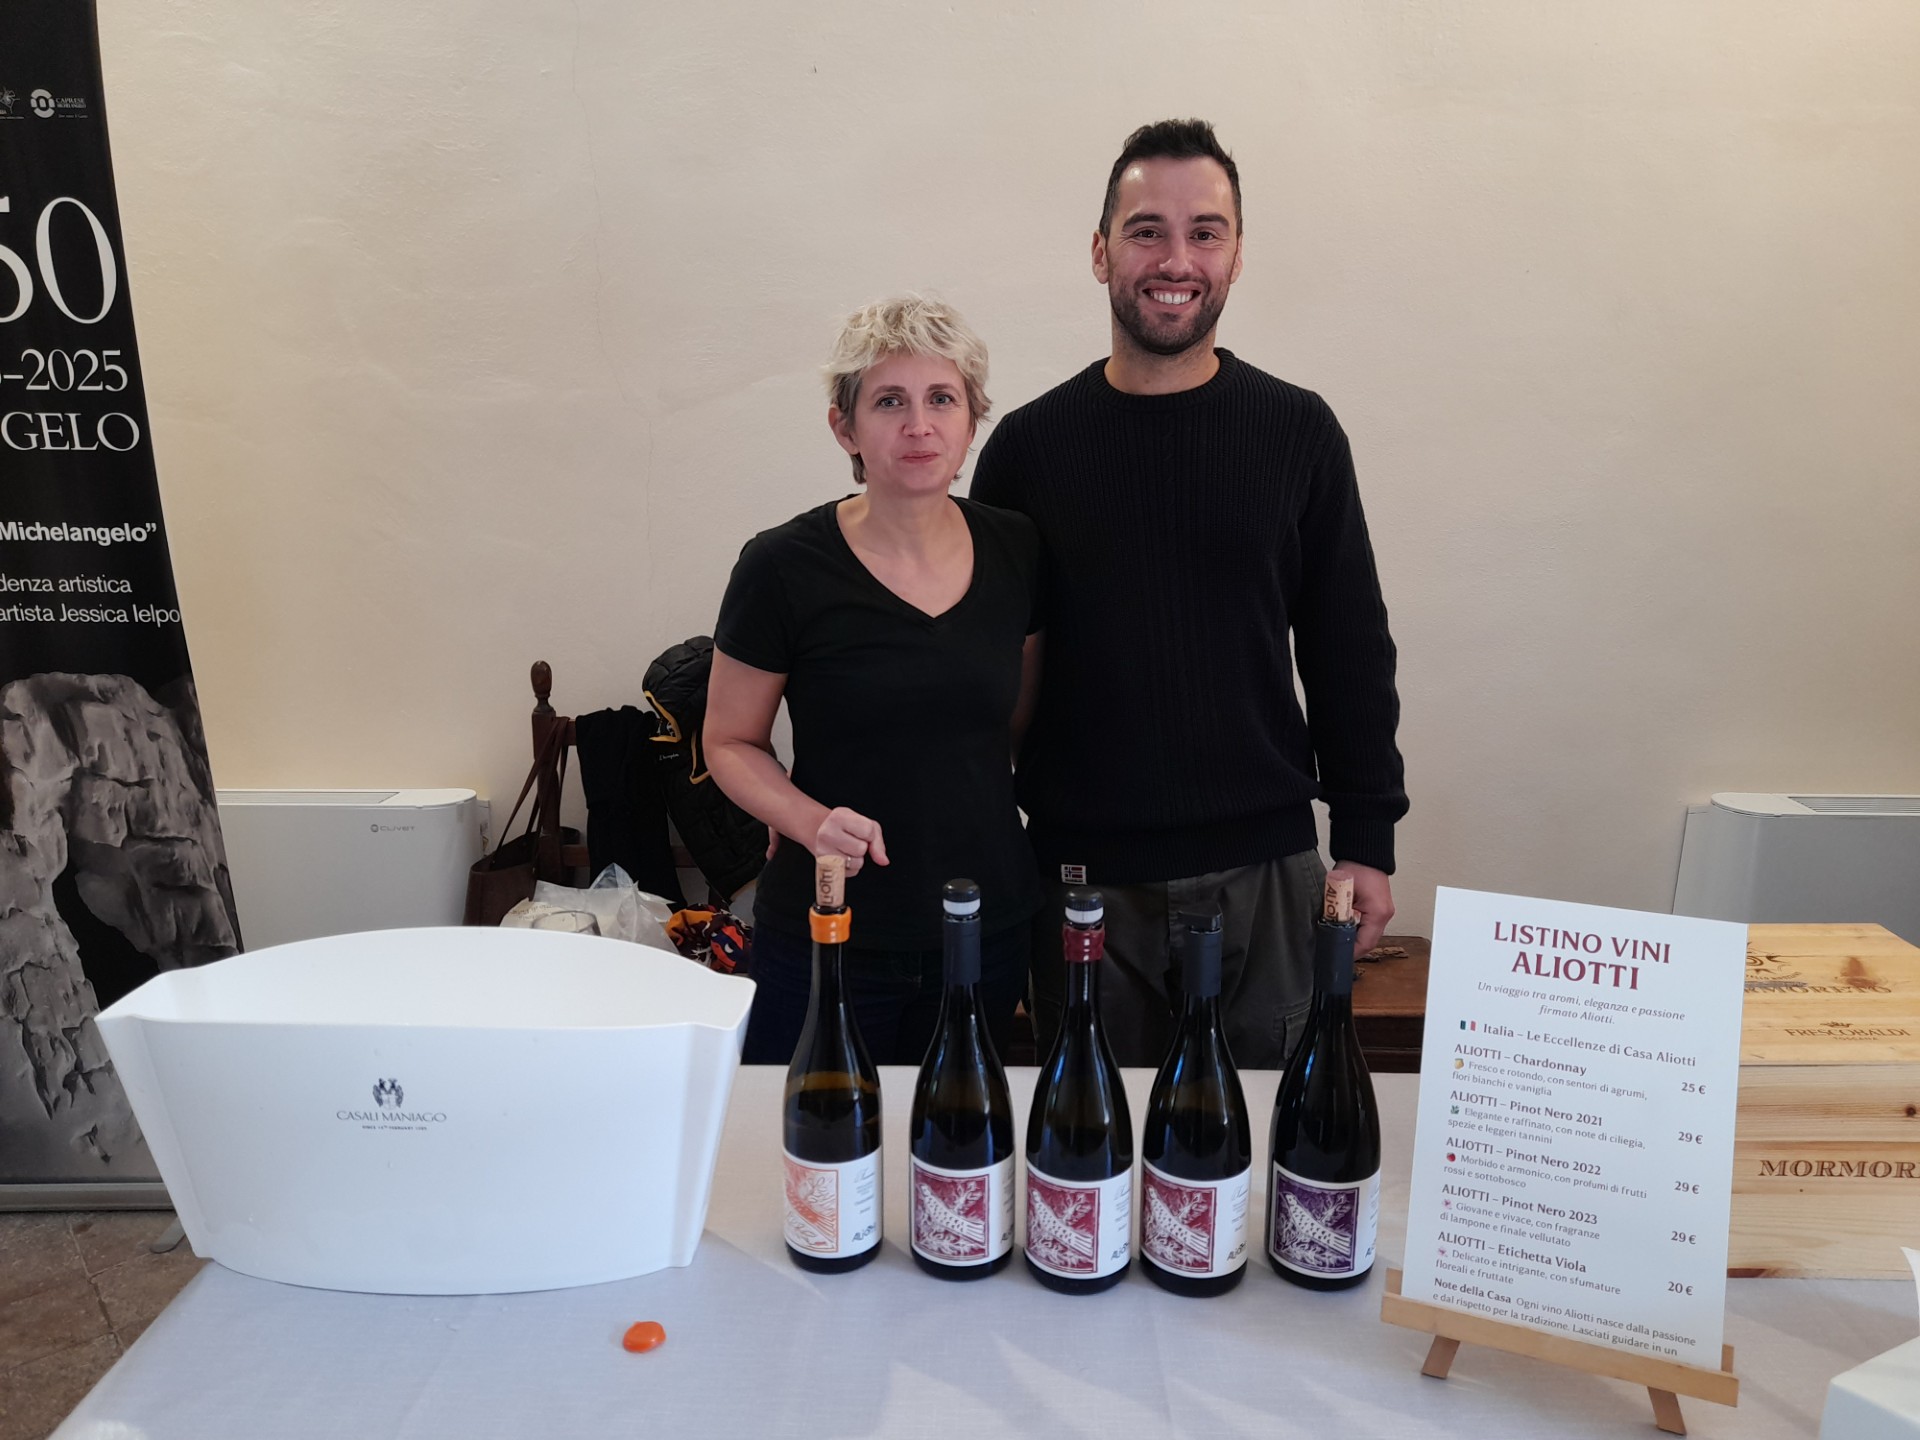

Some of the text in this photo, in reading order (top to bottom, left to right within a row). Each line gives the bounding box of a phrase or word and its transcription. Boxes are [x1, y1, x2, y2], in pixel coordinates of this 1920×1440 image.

[0, 349, 128, 392] –2025
[1, 411, 140, 451] GELO
[0, 573, 132, 594] denza artistica
[60, 603, 129, 623] Jessica
[1494, 921, 1671, 964] LISTINO VINI
[1511, 951, 1639, 990] ALIOTTI
[1478, 981, 1491, 991] Un
[1494, 985, 1530, 998] viaggio
[1532, 991, 1547, 999] tra
[1549, 994, 1581, 1006] aromi,
[1584, 998, 1628, 1012] eleganza
[1639, 1008, 1685, 1020] passione
[1539, 1005, 1615, 1024] firmato Aliotti.
[1483, 1024, 1514, 1037] Italia
[1527, 1031, 1540, 1041] Le
[1544, 1033, 1606, 1053] Eccellenze
[1609, 1044, 1620, 1054] di
[1624, 1046, 1653, 1060] Casa
[1656, 1052, 1696, 1067] Aliotti
[1784, 1028, 1911, 1036] FRESCOBALDI
[1455, 1044, 1502, 1060] ALIOTTI
[1513, 1054, 1587, 1076] Chardonnay
[1453, 1071, 1471, 1081] fiori
[1472, 1075, 1506, 1088] bianchi
[1516, 1083, 1552, 1096] vaniglia
[1469, 1061, 1498, 1073] Fresco
[1507, 1069, 1545, 1082] rotondo,
[1547, 1076, 1564, 1085] con
[1566, 1079, 1597, 1090] sentori
[1600, 1084, 1609, 1092] di
[1611, 1086, 1647, 1100] agrumi,
[1681, 1082, 1706, 1095] 25 €
[336, 1110, 447, 1123] CASALI MANIAGO
[1450, 1090, 1497, 1107] ALIOTTI
[1510, 1101, 1541, 1115] Pinot
[1545, 1107, 1573, 1121] Nero
[1576, 1113, 1602, 1126] 2021
[1448, 1119, 1476, 1129] spezie
[1485, 1124, 1517, 1138] leggeri
[1519, 1131, 1553, 1144] tannini
[1465, 1107, 1502, 1122] Elegante
[1512, 1118, 1554, 1133] raffinato,
[1555, 1126, 1572, 1136] con
[1575, 1130, 1596, 1139] note
[1598, 1132, 1607, 1141] di
[1610, 1134, 1645, 1149] ciliegia,
[1678, 1131, 1703, 1144] 29 €
[1446, 1137, 1493, 1154] ALIOTTI
[1506, 1148, 1537, 1163] Pinot
[1541, 1155, 1569, 1169] Nero
[1573, 1161, 1601, 1175] 2022
[1758, 1159, 1920, 1178] MORMOR
[1443, 1165, 1465, 1176] rossi
[1475, 1172, 1526, 1188] sottobosco
[1460, 1155, 1498, 1169] Morbido
[1507, 1166, 1552, 1181] armonico,
[1554, 1175, 1571, 1183] con
[1573, 1178, 1608, 1191] profumi
[1610, 1184, 1618, 1193] di
[1622, 1186, 1647, 1199] frutti
[1674, 1181, 1700, 1194] 29 €
[1442, 1184, 1490, 1202] ALIOTTI
[1502, 1196, 1534, 1211] Pinot
[1537, 1204, 1566, 1218] Nero
[1569, 1210, 1598, 1225] 2023
[1456, 1202, 1493, 1217] Giovane
[1502, 1212, 1533, 1226] vivace,
[1536, 1220, 1552, 1230] con
[1555, 1223, 1600, 1240] fragranze
[1440, 1212, 1448, 1220] di
[1451, 1214, 1490, 1230] lampone
[1500, 1225, 1526, 1237] finale
[1529, 1232, 1571, 1247] vellutato
[1671, 1231, 1696, 1245] 29 €
[1438, 1232, 1485, 1250] ALIOTTI
[1498, 1244, 1552, 1265] Etichetta
[1556, 1256, 1586, 1273] Viola
[1436, 1259, 1468, 1274] floreali
[1477, 1269, 1514, 1284] fruttate
[1452, 1249, 1490, 1265] Delicato
[1499, 1261, 1547, 1279] intrigante,
[1550, 1272, 1567, 1282] con
[1570, 1277, 1621, 1295] sfumature
[1668, 1281, 1693, 1296] 20 €
[1434, 1278, 1696, 1346] Note della Casa Ogni vino Aliotti nasce dalla passione
[1440, 1293, 1454, 1304] dal
[1456, 1298, 1491, 1312] rispetto
[1493, 1307, 1508, 1316] per
[1511, 1309, 1519, 1319] la
[1521, 1313, 1570, 1331] tradizione.
[1573, 1324, 1609, 1340] Lasciati
[1612, 1335, 1649, 1350] guidare
[1652, 1343, 1661, 1352] in
[1664, 1347, 1677, 1356] un
